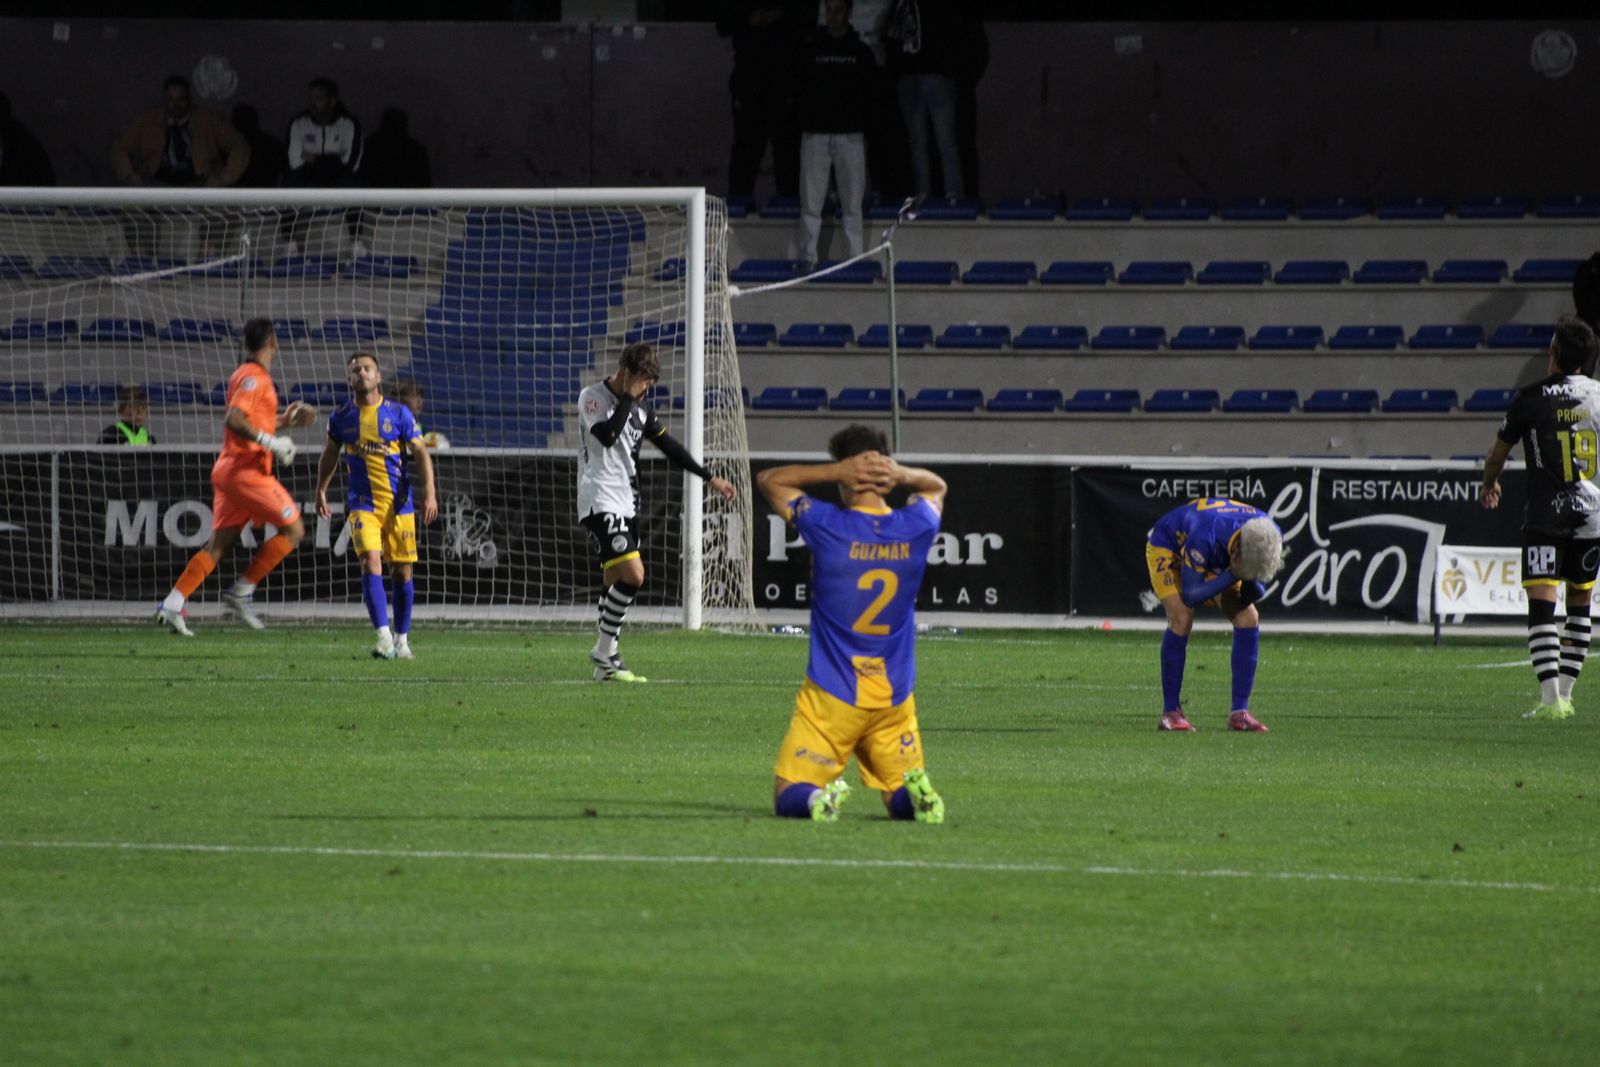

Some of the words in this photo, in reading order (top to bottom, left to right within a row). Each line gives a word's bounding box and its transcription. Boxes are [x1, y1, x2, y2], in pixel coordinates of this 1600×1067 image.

[1557, 430, 1596, 481] 19
[1141, 475, 1266, 499] CAFETERÍA
[852, 568, 899, 636] 2
[1256, 546, 1407, 608] aro
